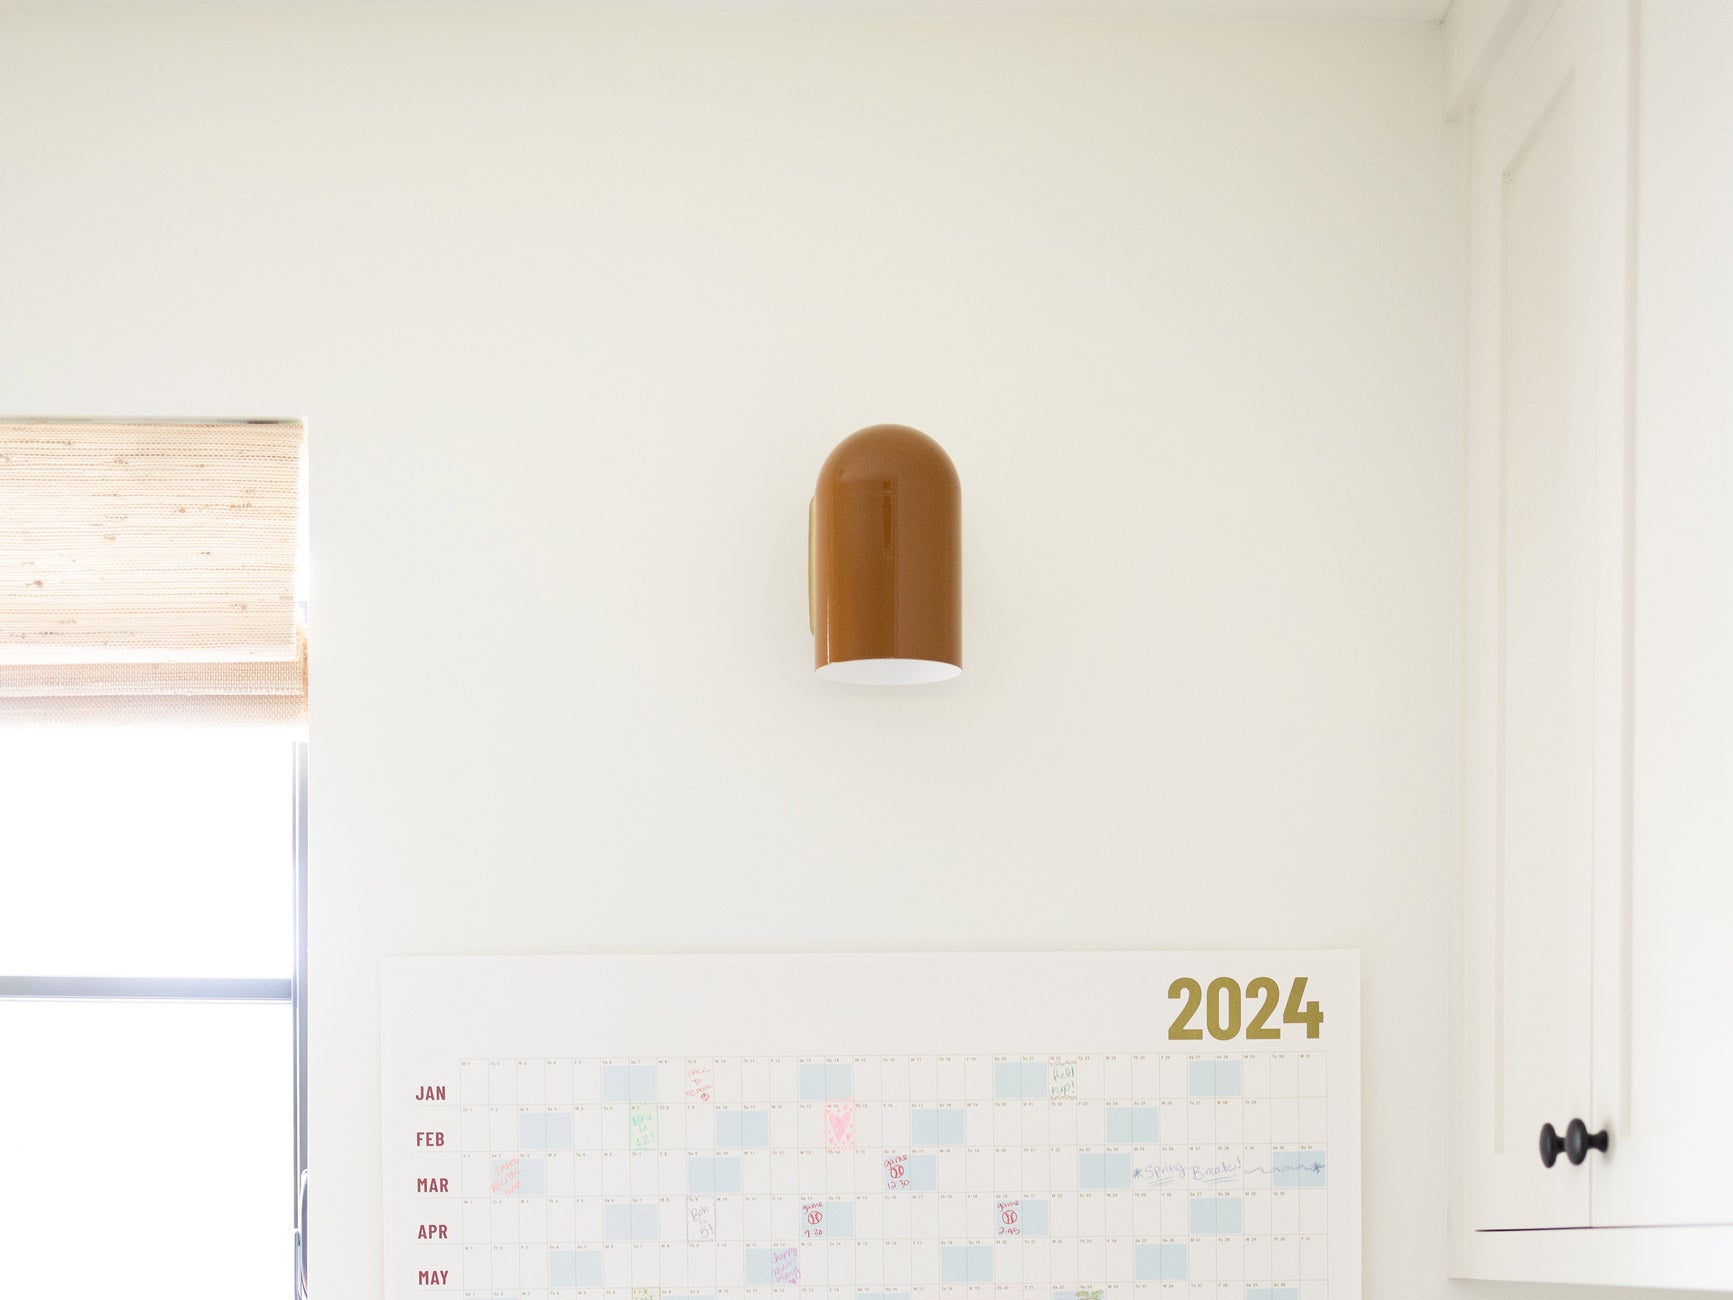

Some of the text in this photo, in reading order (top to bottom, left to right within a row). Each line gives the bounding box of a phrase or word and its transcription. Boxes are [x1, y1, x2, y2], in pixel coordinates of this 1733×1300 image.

[1168, 977, 1324, 1041] 2024
[415, 1085, 446, 1101] JAN
[416, 1132, 445, 1147] FEB
[417, 1178, 449, 1193] MAR
[418, 1224, 448, 1239] APR
[418, 1270, 449, 1286] MAY
